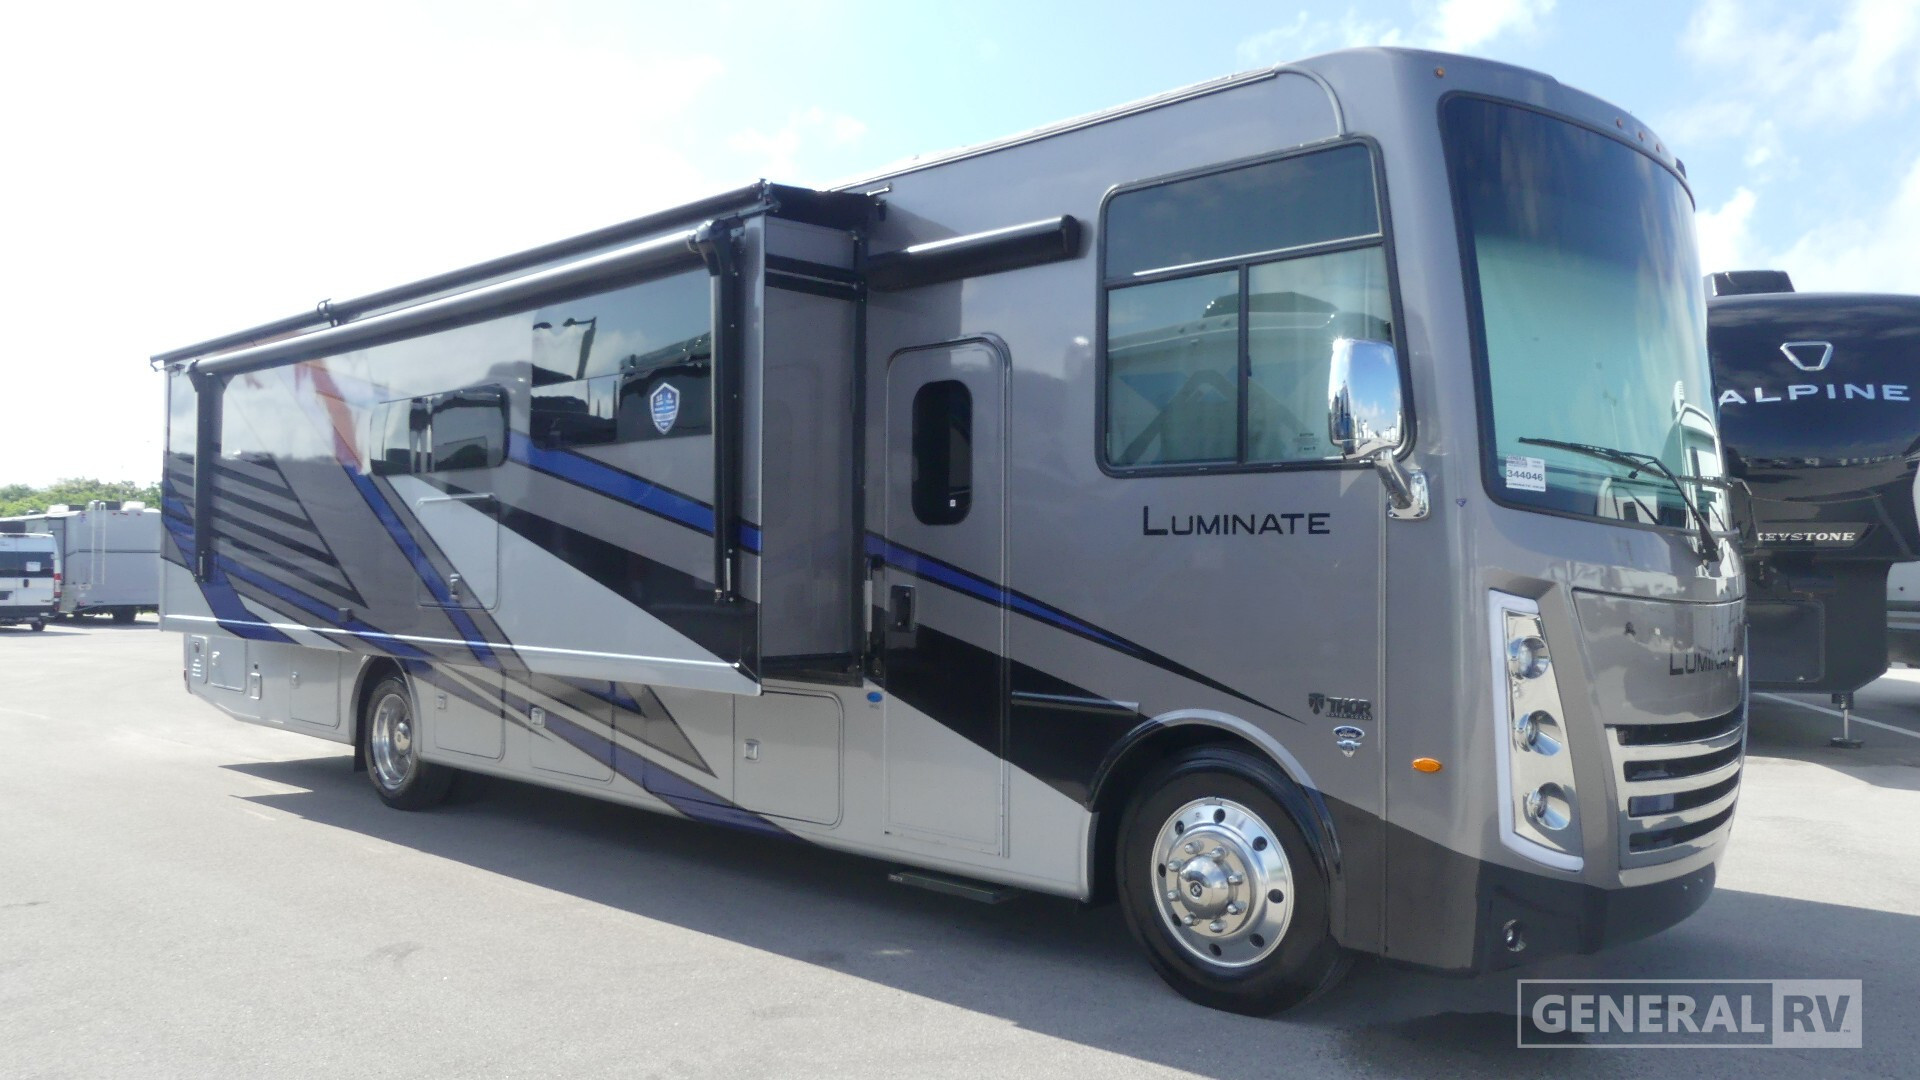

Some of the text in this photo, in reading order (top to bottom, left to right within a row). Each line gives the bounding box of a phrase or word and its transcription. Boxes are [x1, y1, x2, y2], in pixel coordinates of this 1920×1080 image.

[1718, 383, 1911, 405] ALPINE
[1507, 469, 1544, 482] 344046
[1143, 505, 1331, 536] LUMINATE
[1326, 696, 1371, 715] THOR
